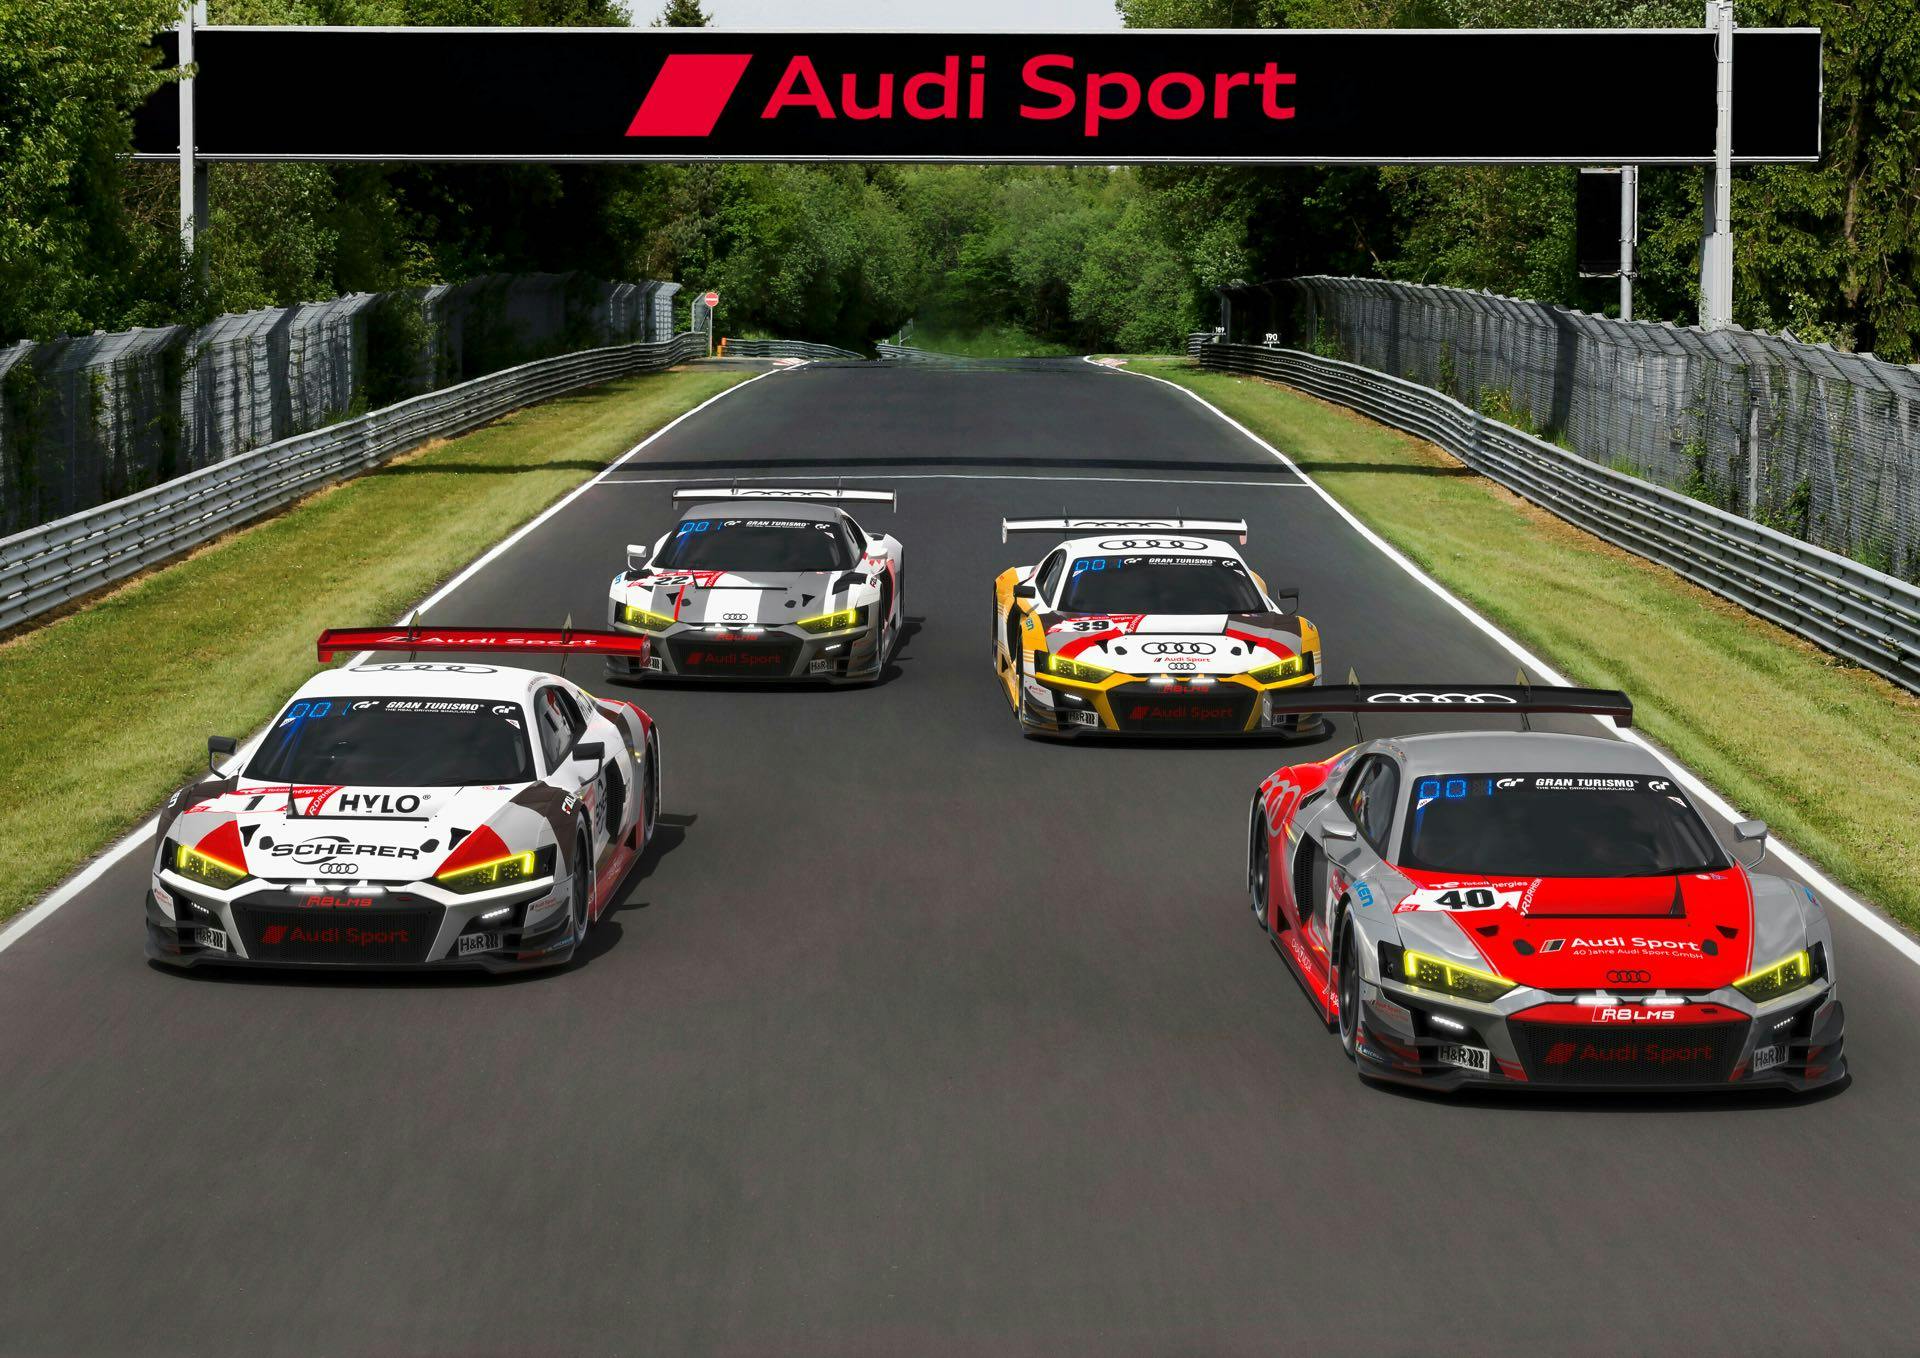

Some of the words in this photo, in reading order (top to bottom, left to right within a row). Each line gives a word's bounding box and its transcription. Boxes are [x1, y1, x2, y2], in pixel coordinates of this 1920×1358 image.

[761, 54, 985, 119] Audi
[1020, 53, 1297, 137] Sport
[1265, 333, 1278, 341] 190
[654, 575, 690, 586] 22
[1073, 620, 1110, 632] 39
[505, 637, 598, 647] Sport
[704, 652, 736, 665] Audi
[740, 652, 781, 667] Sport
[386, 701, 422, 709] GRAN
[1151, 706, 1187, 718] Audi
[1191, 705, 1233, 721] Sport
[1535, 778, 1573, 787] GRAN
[244, 794, 266, 812] 1
[271, 843, 420, 860] SCHERER
[1433, 888, 1496, 910] 40
[290, 926, 340, 944] Audi
[346, 926, 410, 948] Sport
[460, 936, 485, 952] H&R
[1570, 936, 1626, 948] Audi
[1630, 937, 1701, 952] Sport
[1588, 949, 1615, 957] Jahre
[1641, 949, 1670, 957] Sport
[1672, 951, 1704, 960] GmbH
[1601, 1008, 1632, 1021] R8
[1633, 1010, 1675, 1021] LMS
[1440, 1045, 1467, 1064] H&R
[1579, 1043, 1639, 1062] Audi
[1646, 1043, 1713, 1066] Sport
[1755, 1047, 1776, 1067] H&R
